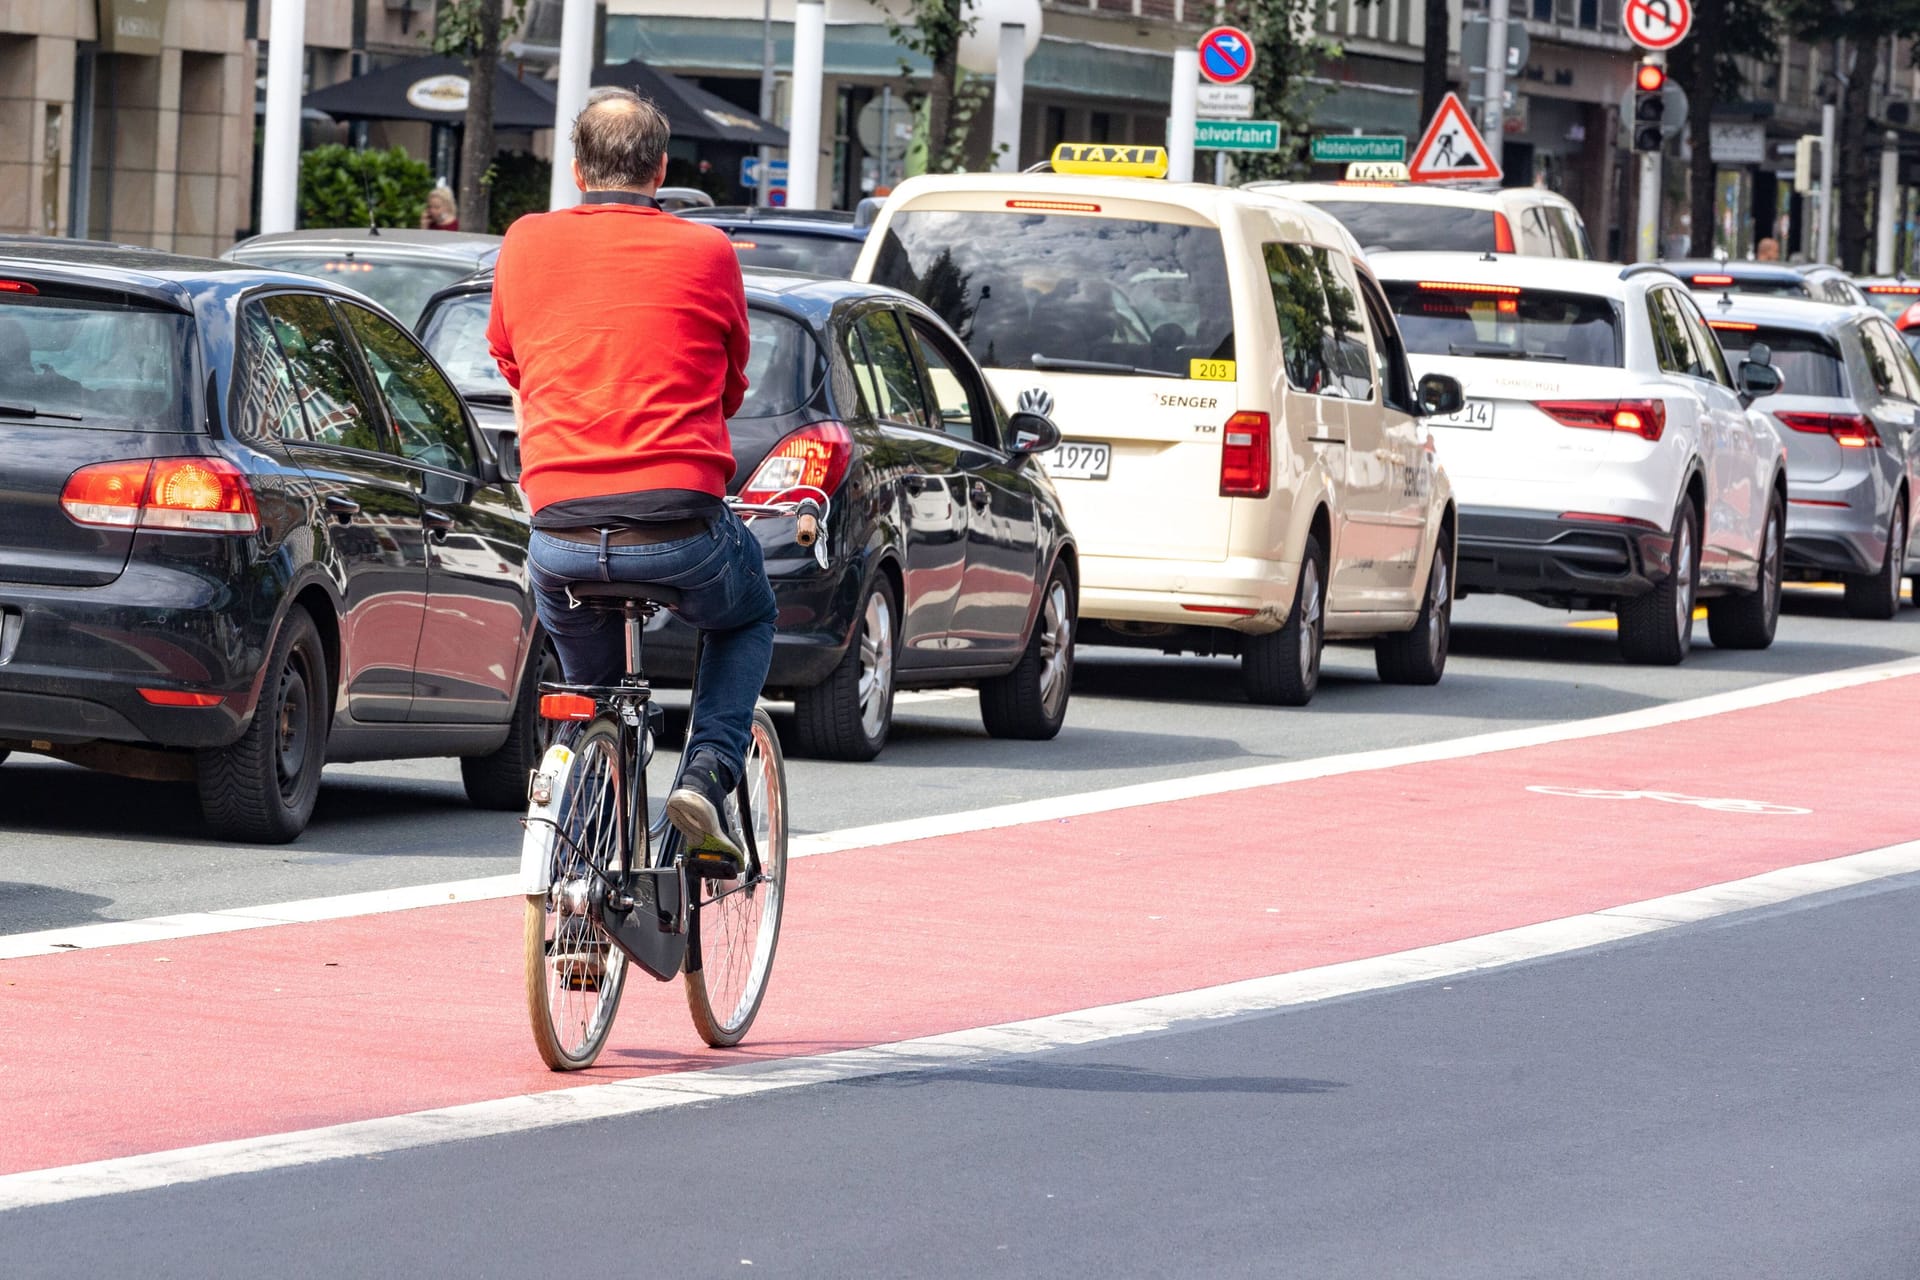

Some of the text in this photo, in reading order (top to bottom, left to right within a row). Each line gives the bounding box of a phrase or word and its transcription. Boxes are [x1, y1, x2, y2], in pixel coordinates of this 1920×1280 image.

[1070, 146, 1145, 163] TAXI
[1317, 141, 1400, 156] Hotelvorfahrt
[1355, 166, 1400, 178] TAXI
[1200, 363, 1227, 378] 203
[1160, 394, 1218, 409] SENGER
[1464, 402, 1487, 424] 14
[1195, 425, 1217, 433] TDI
[1053, 446, 1106, 470] 1979
